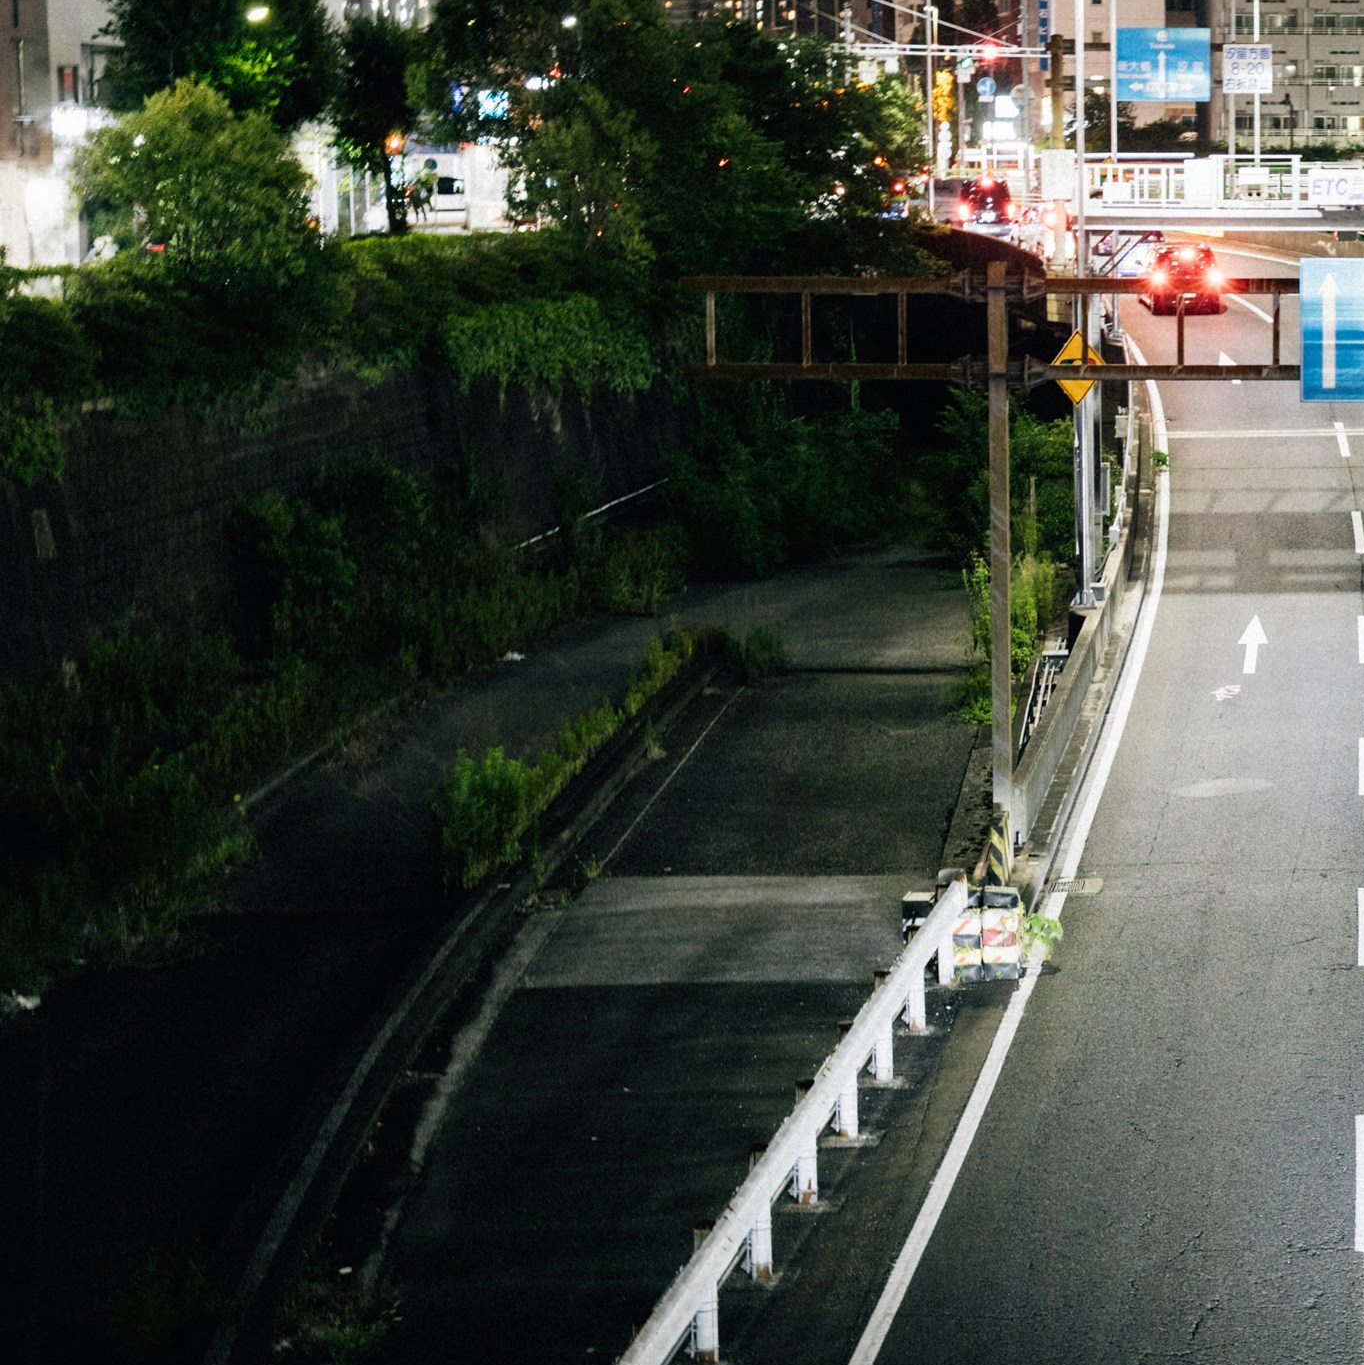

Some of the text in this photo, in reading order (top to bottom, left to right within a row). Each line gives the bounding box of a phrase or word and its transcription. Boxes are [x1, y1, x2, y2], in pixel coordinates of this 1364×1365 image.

[1225, 48, 1270, 60] 汐留方面
[1231, 62, 1264, 75] 8-20
[1312, 178, 1349, 196] ETC
